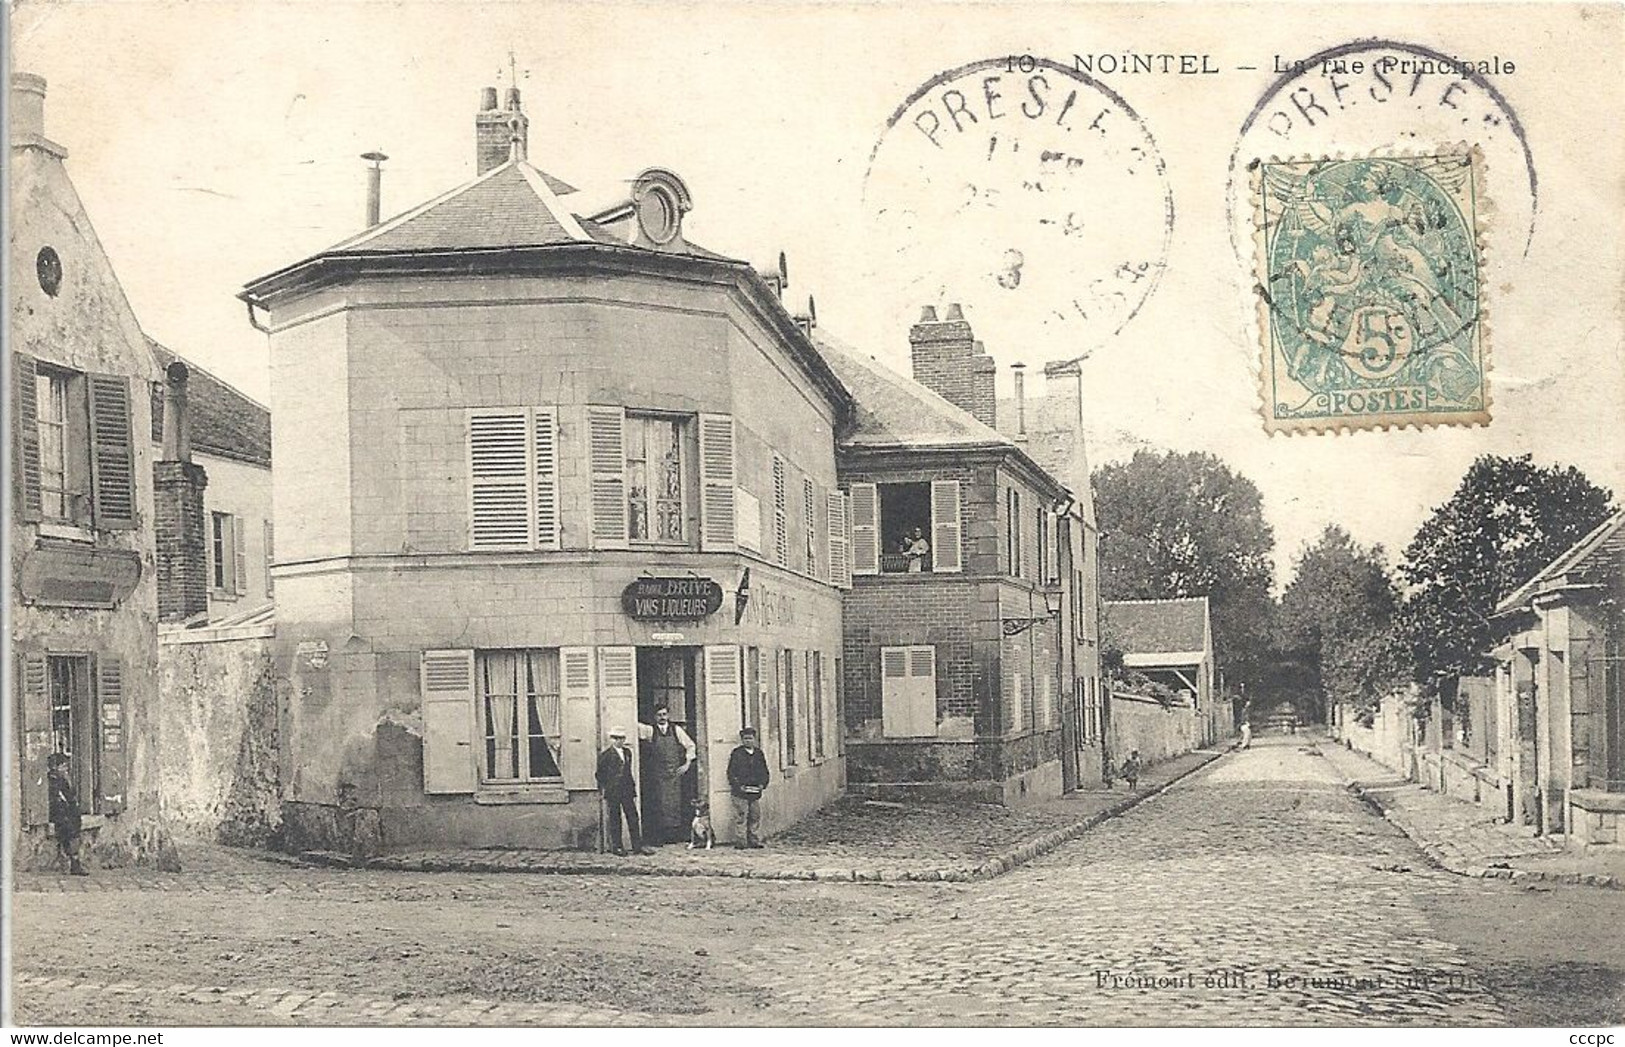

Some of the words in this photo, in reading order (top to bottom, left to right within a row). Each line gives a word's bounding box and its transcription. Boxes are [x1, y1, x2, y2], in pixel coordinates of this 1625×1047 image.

[1331, 389, 1424, 414] POSTES
[635, 598, 659, 615] VINS
[661, 598, 707, 617] LIQUEURS
